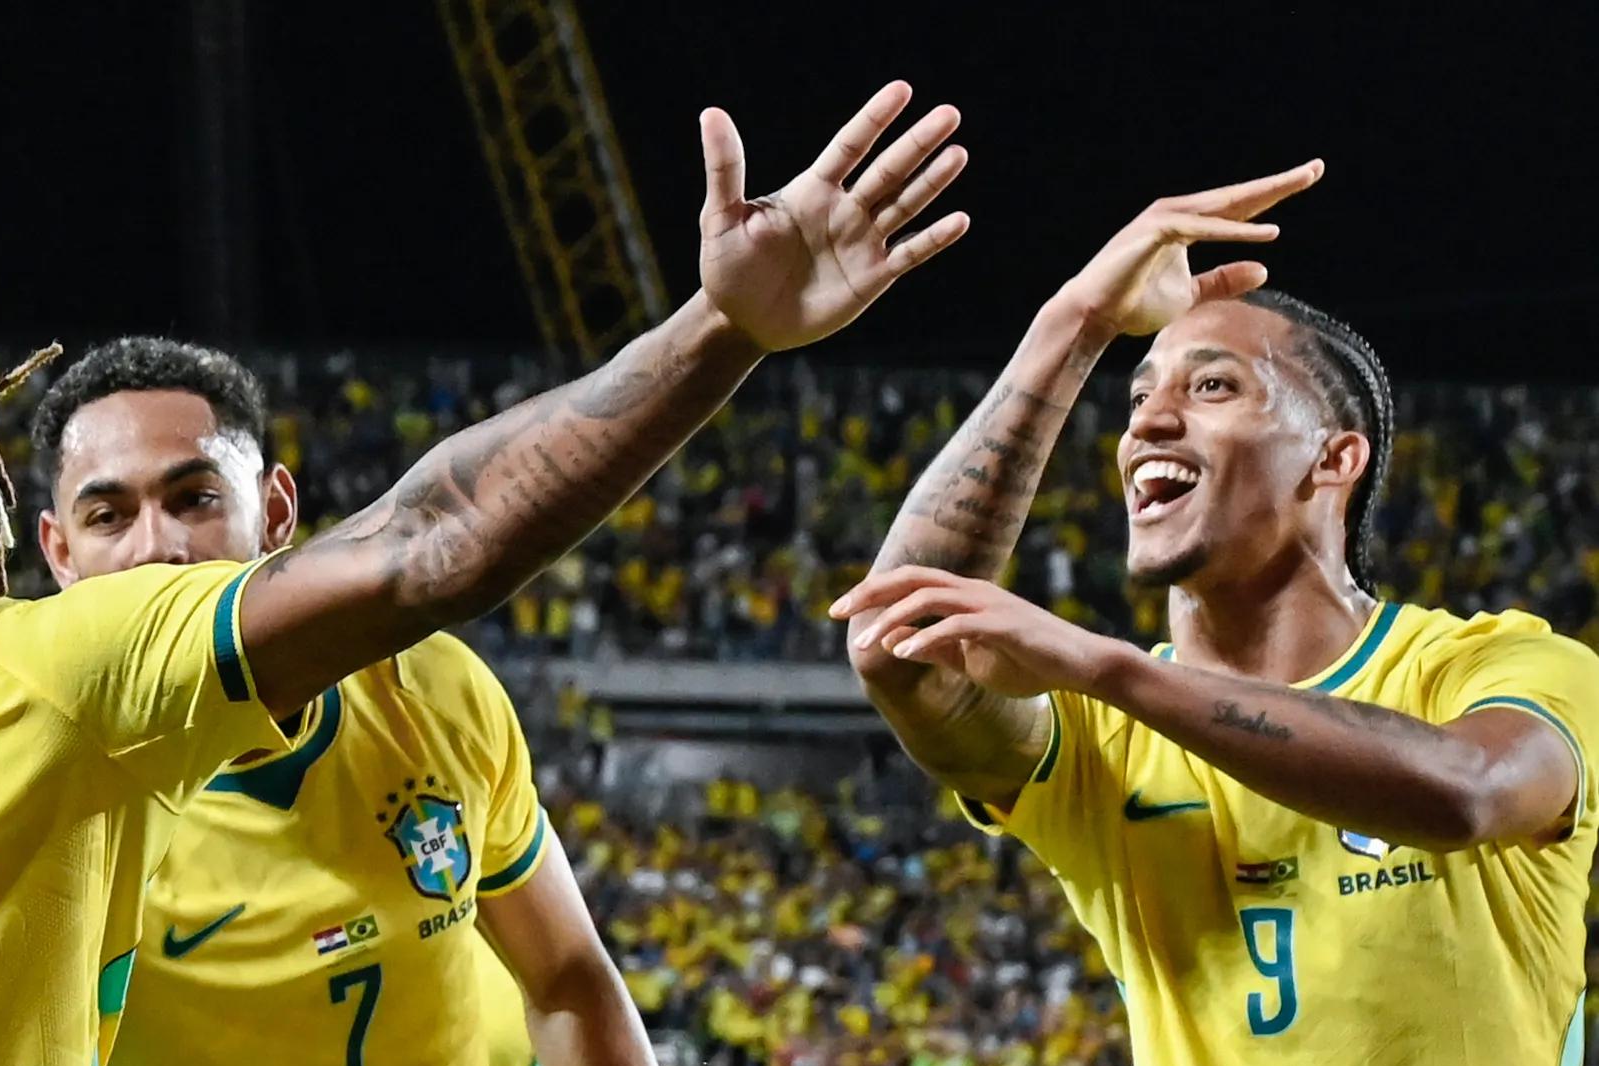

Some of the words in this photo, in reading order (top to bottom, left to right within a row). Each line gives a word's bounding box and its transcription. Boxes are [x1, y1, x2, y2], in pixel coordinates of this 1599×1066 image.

[420, 834, 448, 857] CBF
[1338, 861, 1433, 896] BRASIL
[1238, 906, 1299, 1037] 9
